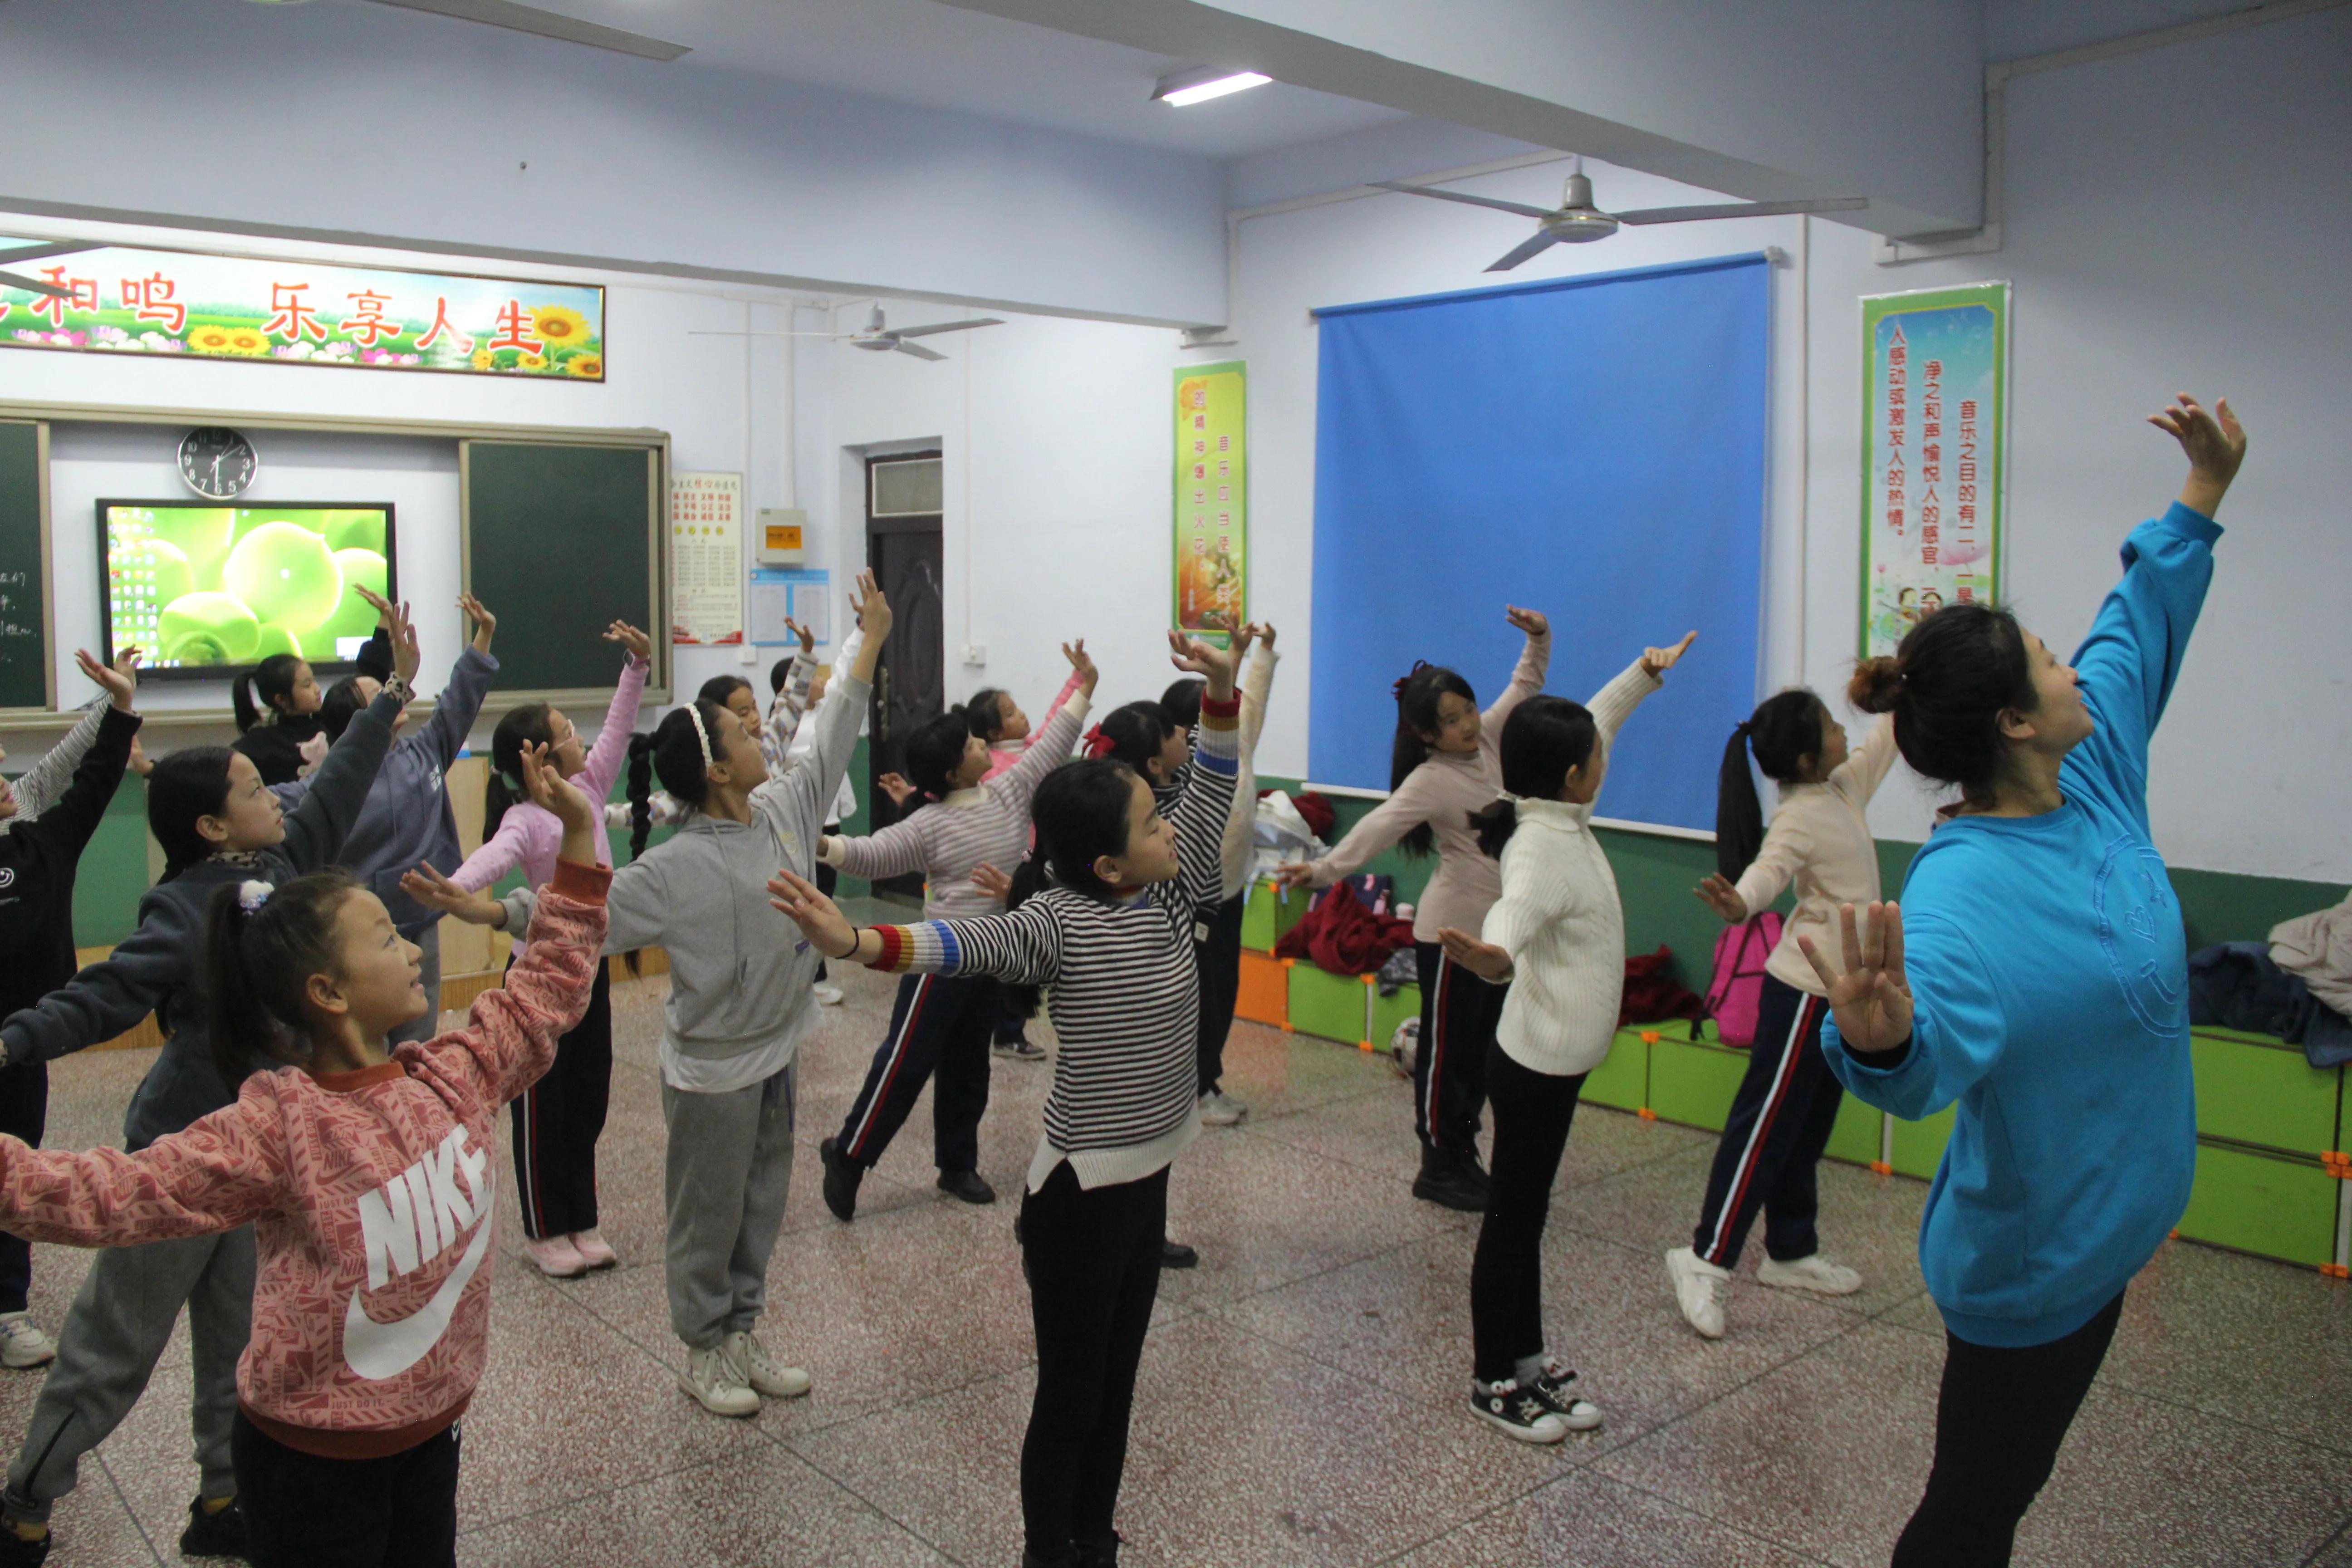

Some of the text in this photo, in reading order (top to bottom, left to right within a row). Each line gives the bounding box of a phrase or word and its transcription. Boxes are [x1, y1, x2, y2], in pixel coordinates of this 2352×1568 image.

[0, 265, 544, 354] 和鸣 乐享人生
[183, 454, 192, 466] 9
[242, 457, 250, 470] 3
[188, 468, 196, 481] 8
[239, 471, 246, 483] 4
[200, 478, 208, 490] 7
[214, 482, 222, 495] 6
[228, 480, 238, 494] 5
[323, 1149, 355, 1171] NIKE
[358, 1123, 489, 1292] NIKE
